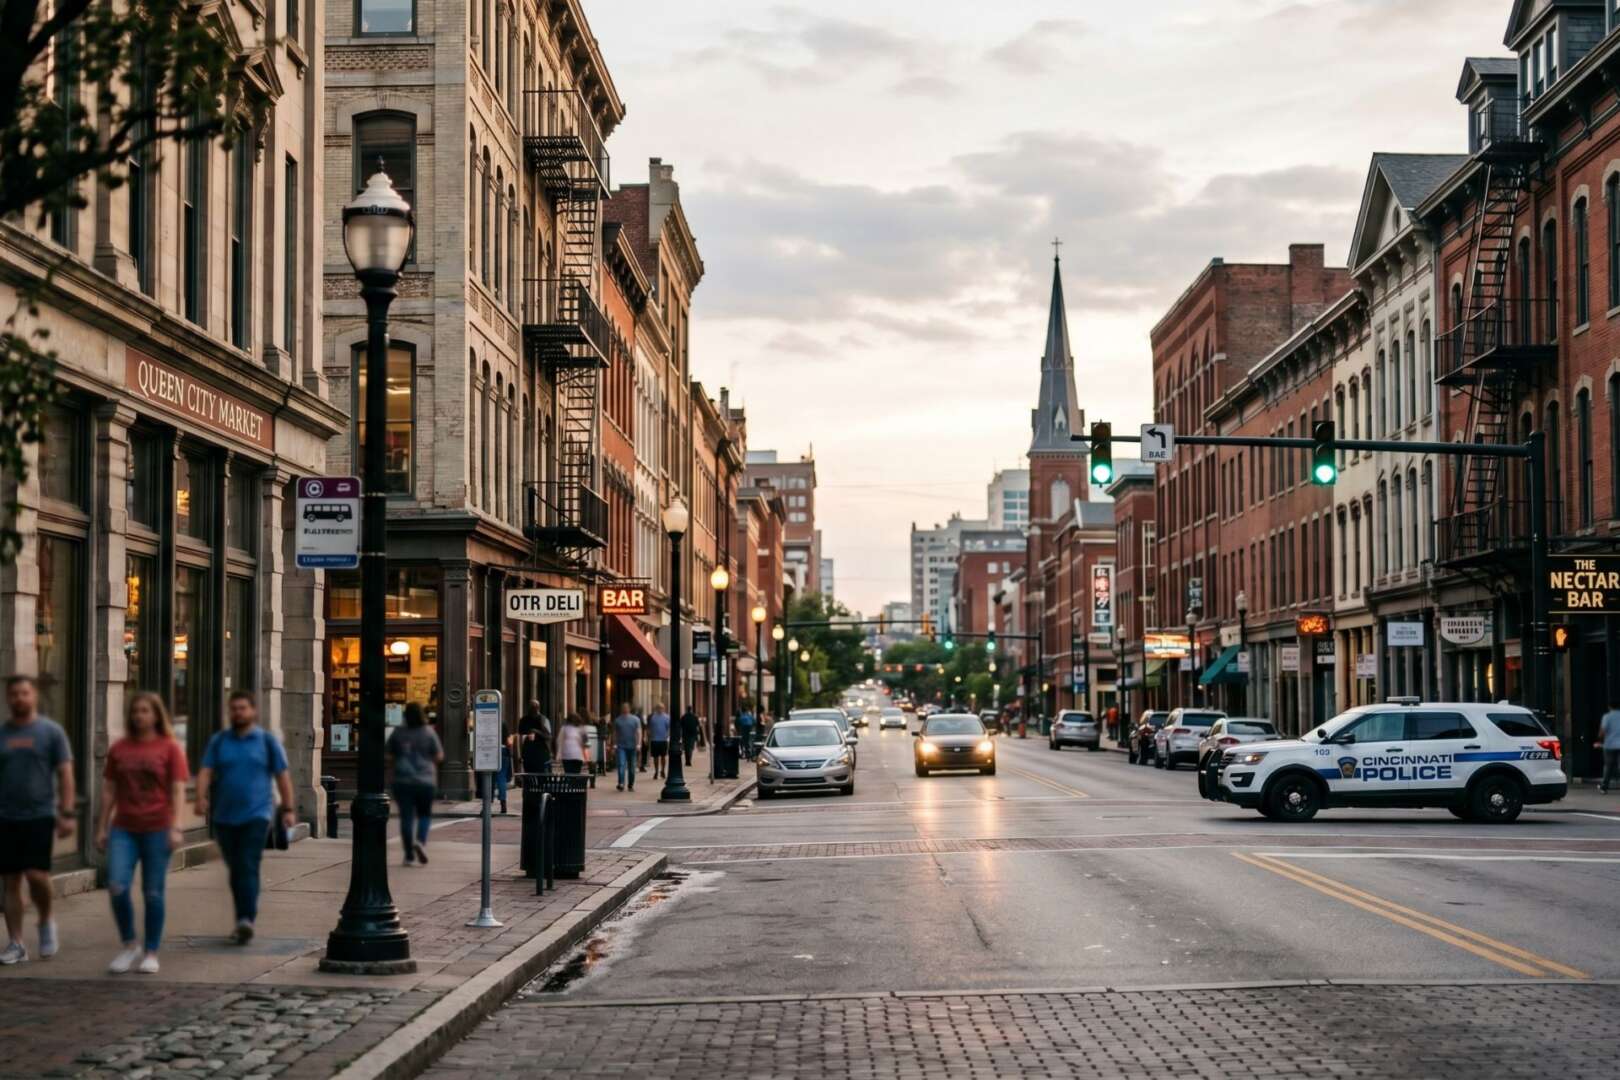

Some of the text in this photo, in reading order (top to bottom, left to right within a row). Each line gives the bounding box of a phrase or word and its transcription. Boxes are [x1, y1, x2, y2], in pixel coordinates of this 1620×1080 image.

[138, 361, 263, 441] QUEEN CITY MARKET
[1574, 559, 1596, 570] THE
[1550, 571, 1620, 589] NECTAR
[510, 595, 580, 611] OTR DELI
[602, 590, 644, 607] BAR
[1567, 591, 1604, 608] BAR
[1362, 754, 1453, 767] CINCINNATI
[1362, 765, 1452, 782] POLICE
